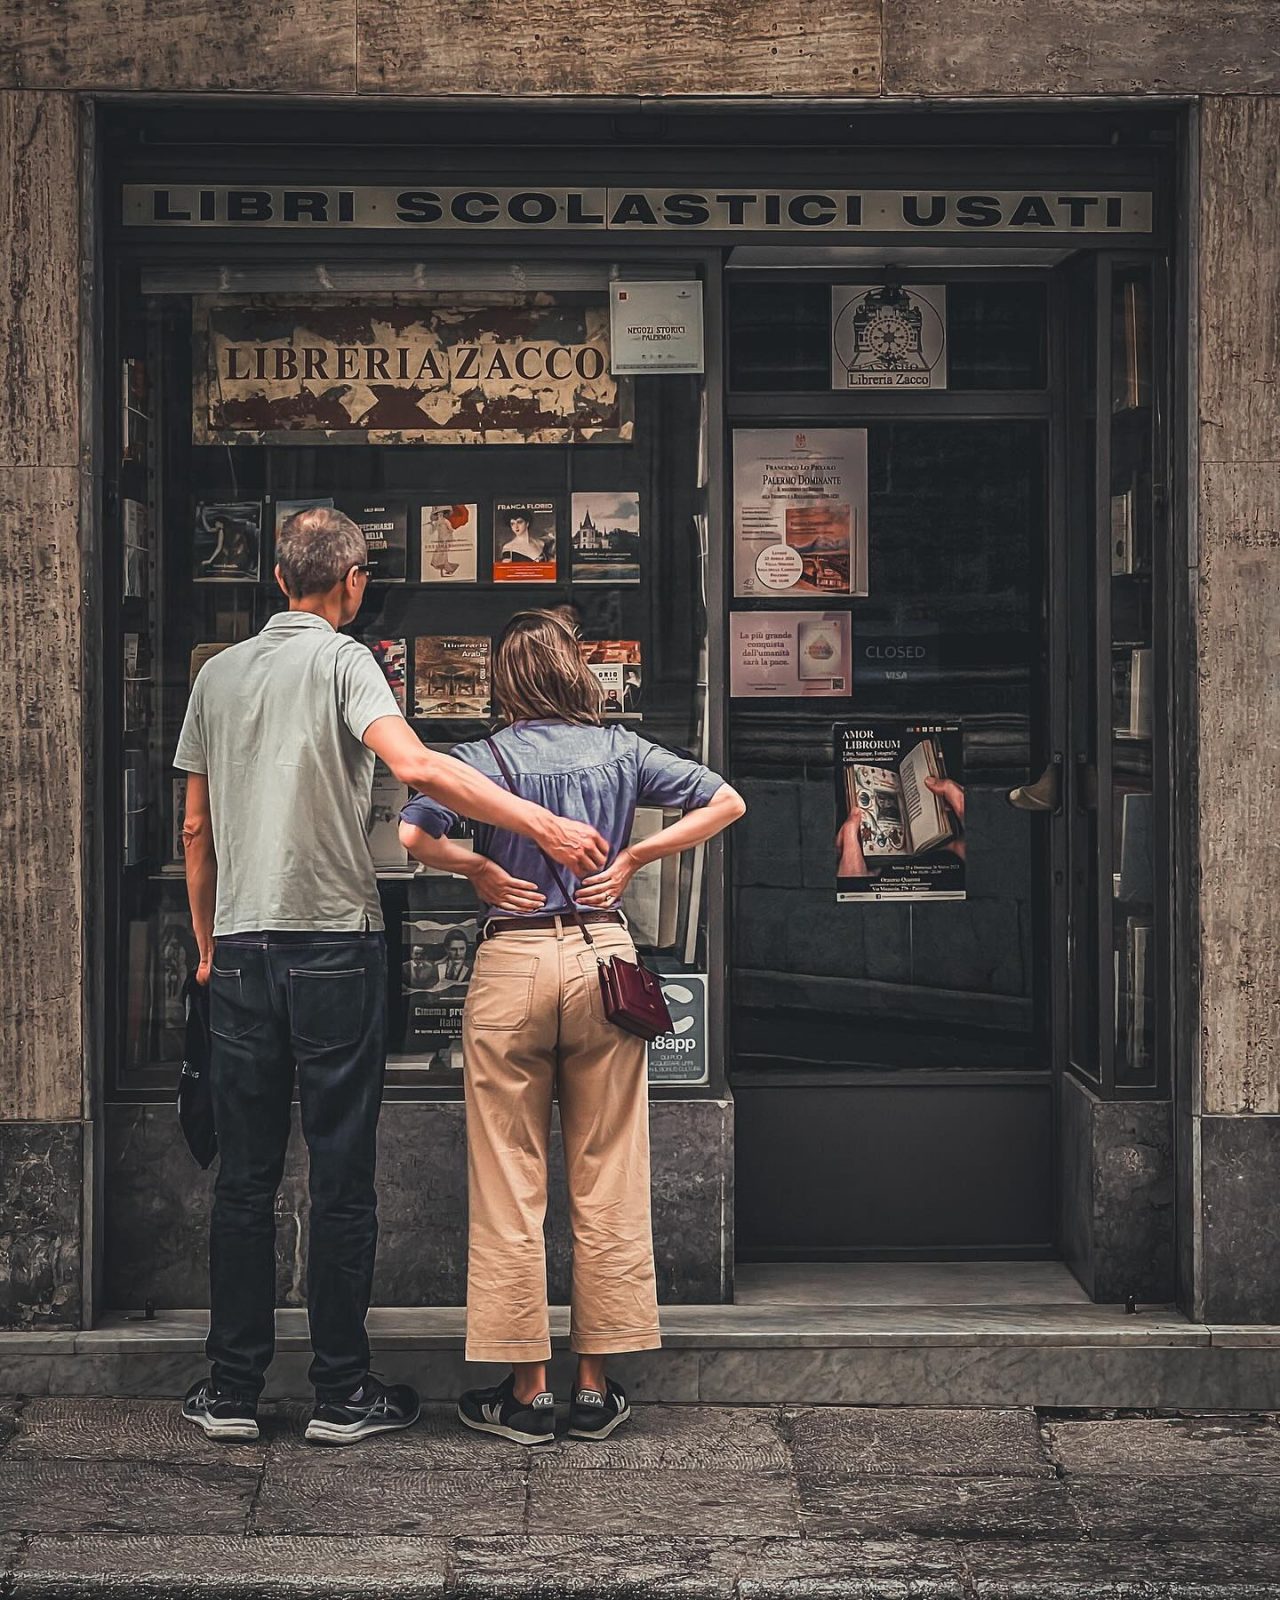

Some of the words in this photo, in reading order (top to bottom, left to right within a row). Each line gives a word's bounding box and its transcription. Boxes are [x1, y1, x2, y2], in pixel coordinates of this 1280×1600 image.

[153, 190, 354, 222] LIBRI
[396, 191, 862, 226] SCOLASTICI
[902, 194, 1123, 227] USATI
[627, 326, 654, 334] NEGOZI
[656, 326, 686, 334] STORICI
[225, 347, 443, 380] LIBRERIA
[454, 347, 605, 380] ZACCO
[849, 373, 893, 385] Libreria
[896, 373, 929, 385] Zacco
[762, 474, 797, 485] PALERMO
[798, 474, 842, 485] DOMINANTE
[751, 632, 763, 640] più
[765, 632, 792, 640] grande
[865, 645, 926, 659] CLOSED
[885, 671, 908, 680] VISA
[842, 730, 875, 740] AMOR
[845, 740, 901, 750] LIBRORUM
[414, 1007, 447, 1016] Cinema
[579, 1393, 603, 1405] VEJA
